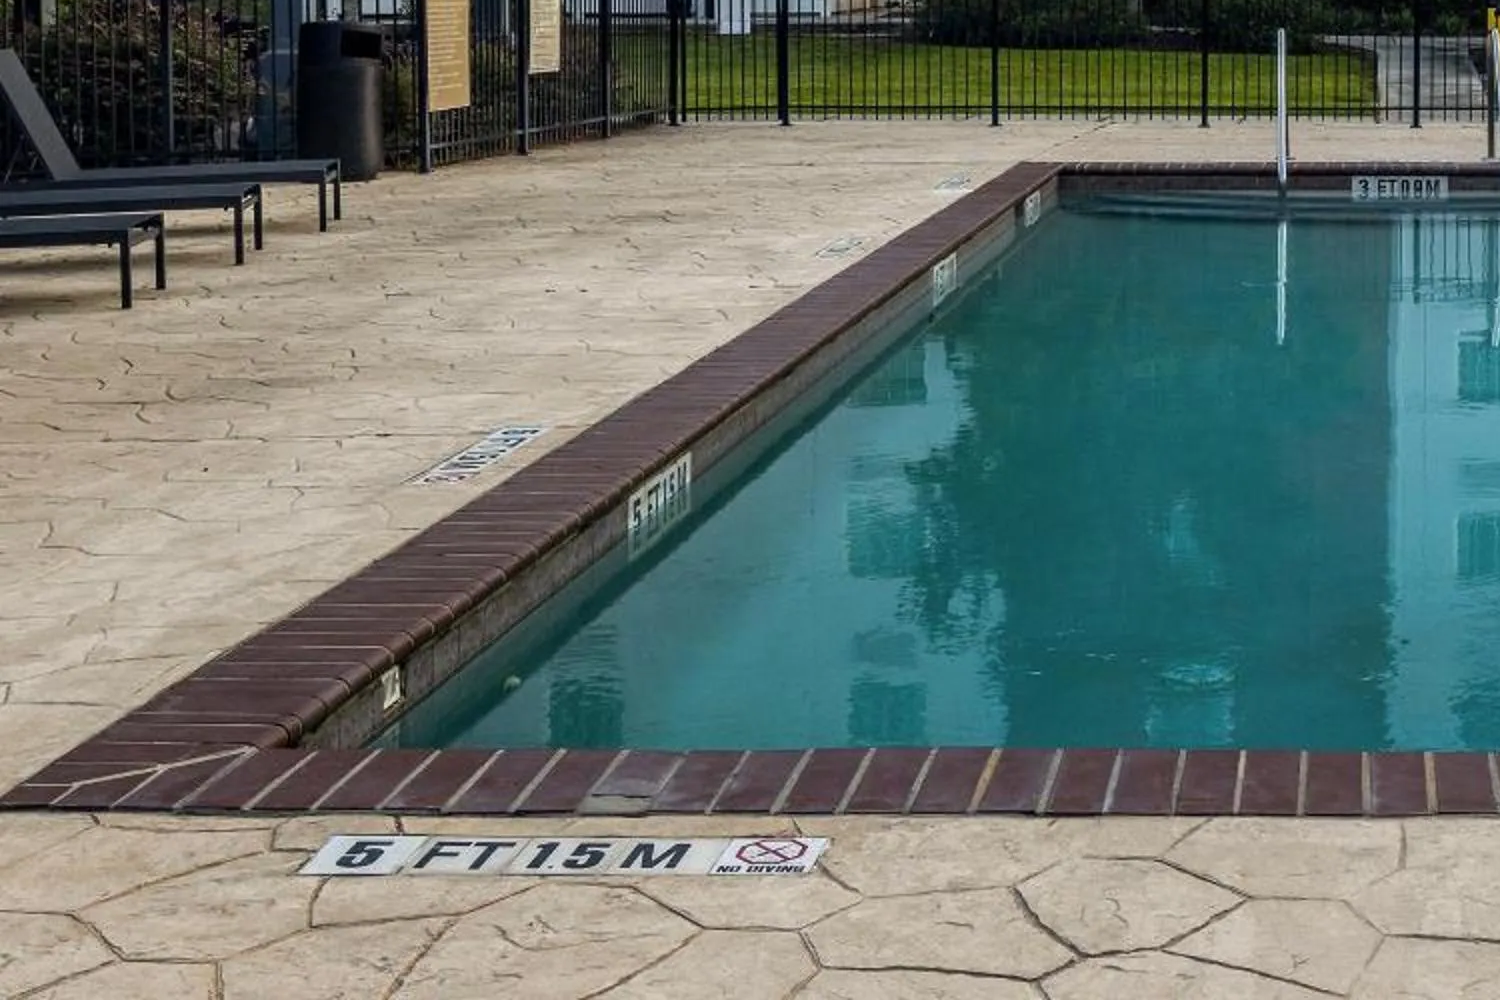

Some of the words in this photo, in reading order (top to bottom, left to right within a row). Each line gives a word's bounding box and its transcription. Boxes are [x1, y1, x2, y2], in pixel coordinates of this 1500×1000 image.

[336, 841, 394, 868] 5
[413, 841, 516, 870] FT
[620, 843, 692, 869] M
[716, 865, 741, 873] NO
[746, 865, 806, 873] DIVING
